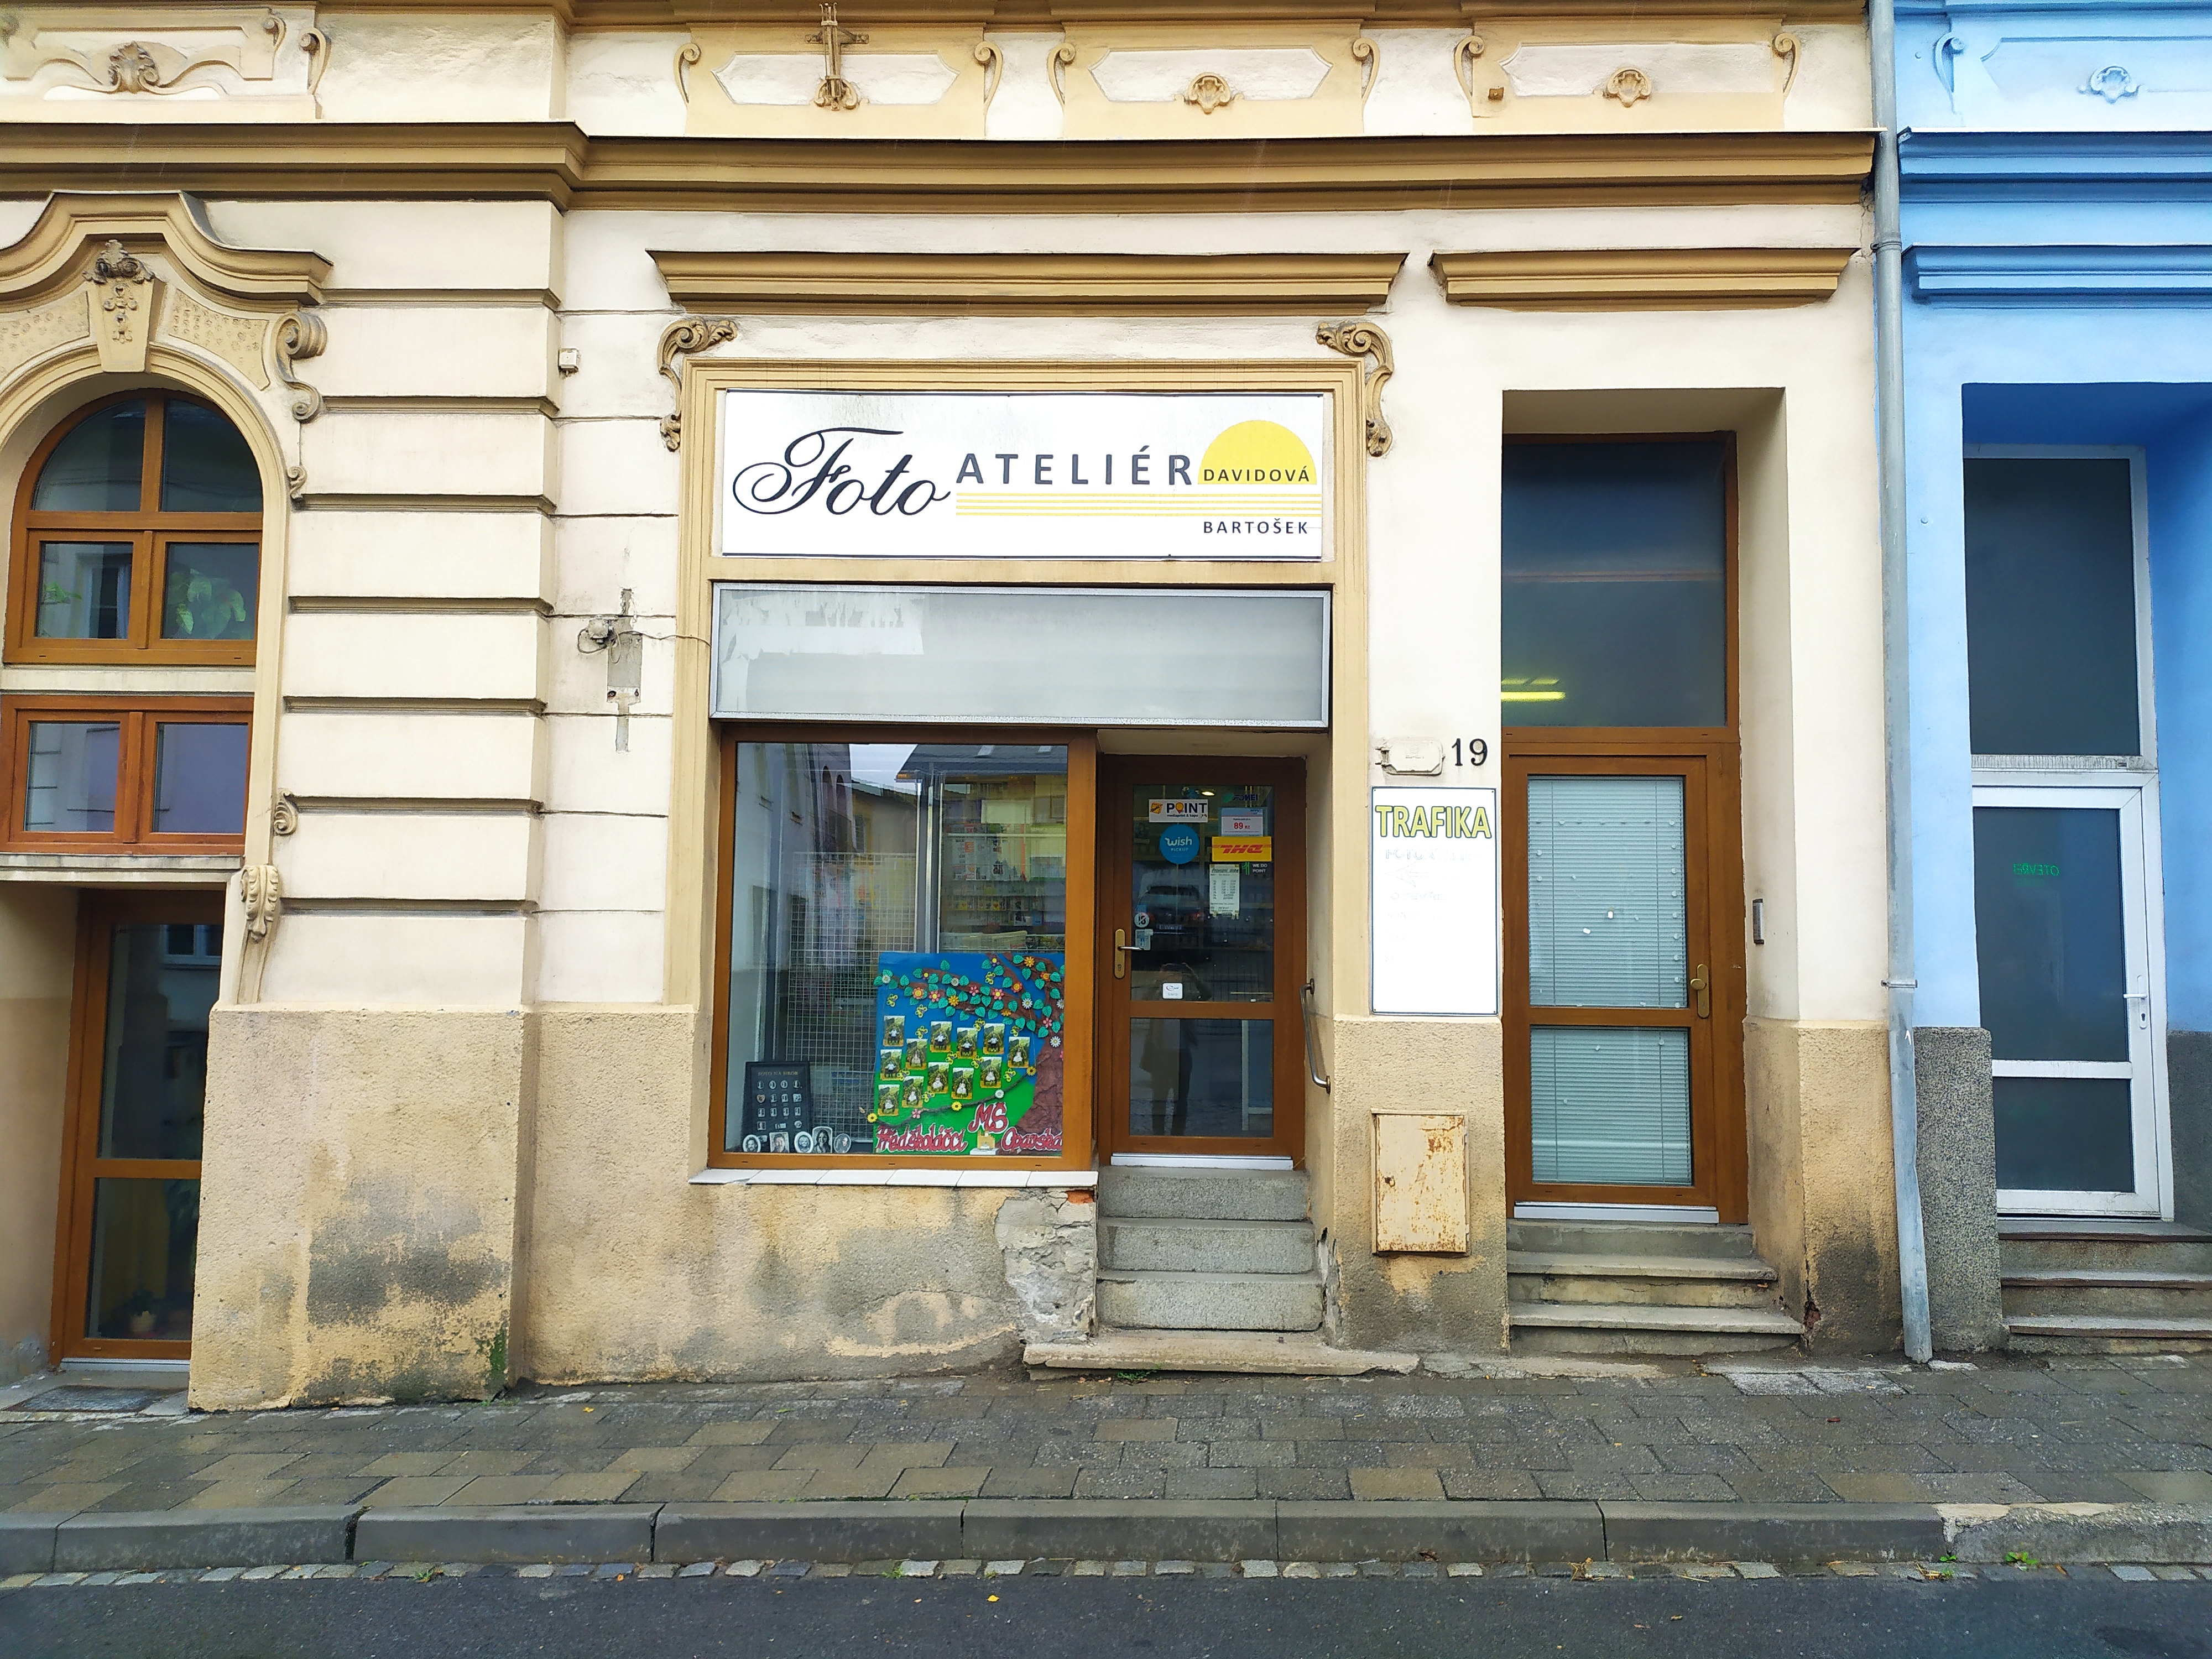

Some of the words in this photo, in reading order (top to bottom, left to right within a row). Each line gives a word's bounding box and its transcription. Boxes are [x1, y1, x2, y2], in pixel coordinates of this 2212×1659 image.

[733, 427, 951, 515] Foto
[956, 446, 1192, 486] ATELIÉR
[1203, 466, 1310, 482] DAVIDOVÁ
[1203, 518, 1308, 534] BARTOŠEK
[1452, 738, 1488, 766] 19
[1375, 805, 1492, 839] TRAFIKA
[1165, 836, 1192, 846] wish
